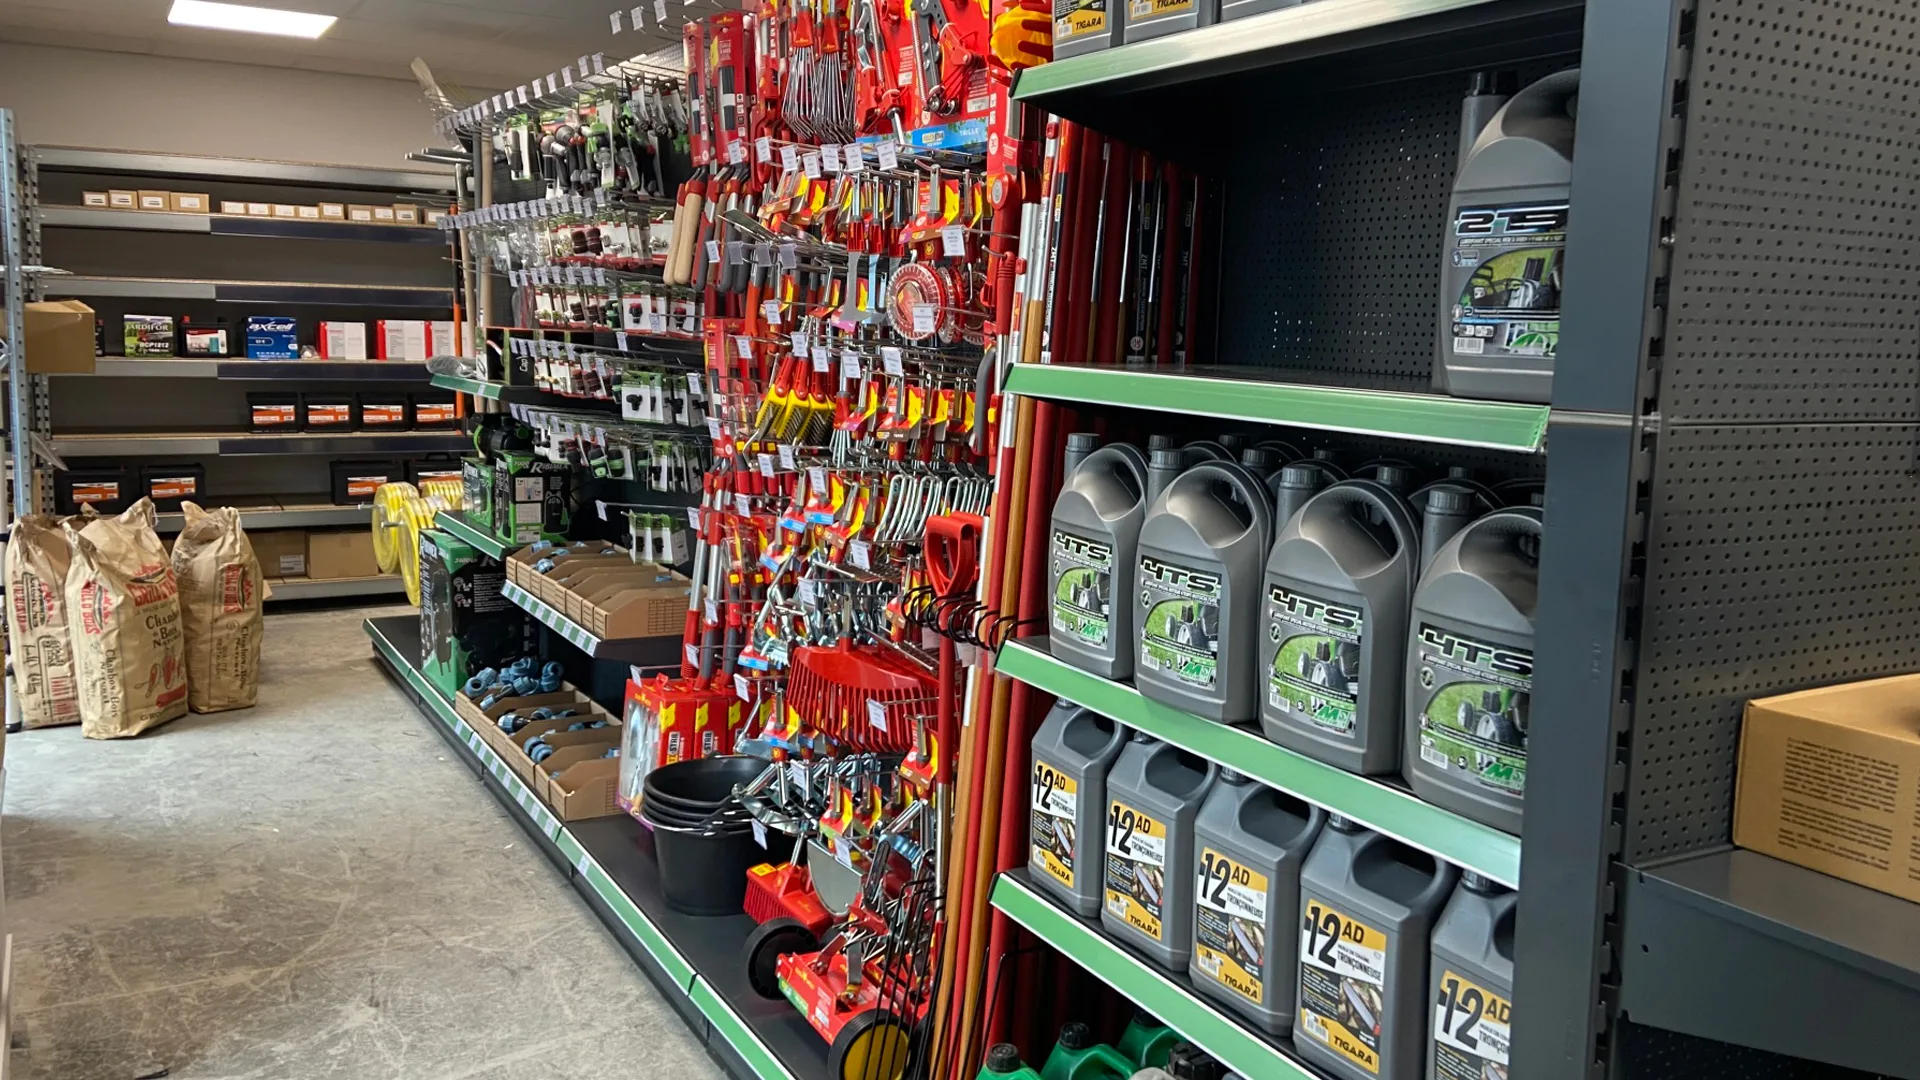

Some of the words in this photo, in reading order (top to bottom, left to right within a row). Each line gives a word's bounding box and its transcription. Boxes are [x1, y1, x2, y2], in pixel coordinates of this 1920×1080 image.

[1076, 16, 1102, 31] TIGARA
[1049, 245, 1058, 266] ZMT
[126, 324, 169, 332] JARDIFOR
[1055, 531, 1110, 561] 4TS
[1143, 559, 1219, 594] 4TS
[1271, 588, 1360, 629] 4TS
[1424, 628, 1533, 675] 4TS
[669, 733, 679, 752] STAR
[704, 732, 713, 751] STAR
[1036, 764, 1054, 811] 12
[1054, 773, 1066, 790] AD
[1111, 804, 1136, 856] 12
[1135, 815, 1151, 834] AD
[1048, 862, 1070, 882] TIGARA
[1202, 853, 1231, 910] 12
[1232, 865, 1250, 886] AD
[1130, 914, 1158, 937] TIGARA
[1308, 905, 1341, 968] 12
[1342, 920, 1365, 944] AD
[1337, 950, 1381, 982] TRONÇONNEUSE
[1223, 974, 1258, 999] TIGARA
[1442, 979, 1485, 1051] 12
[1485, 998, 1511, 1024] AD
[1333, 1035, 1373, 1066] TIGARA
